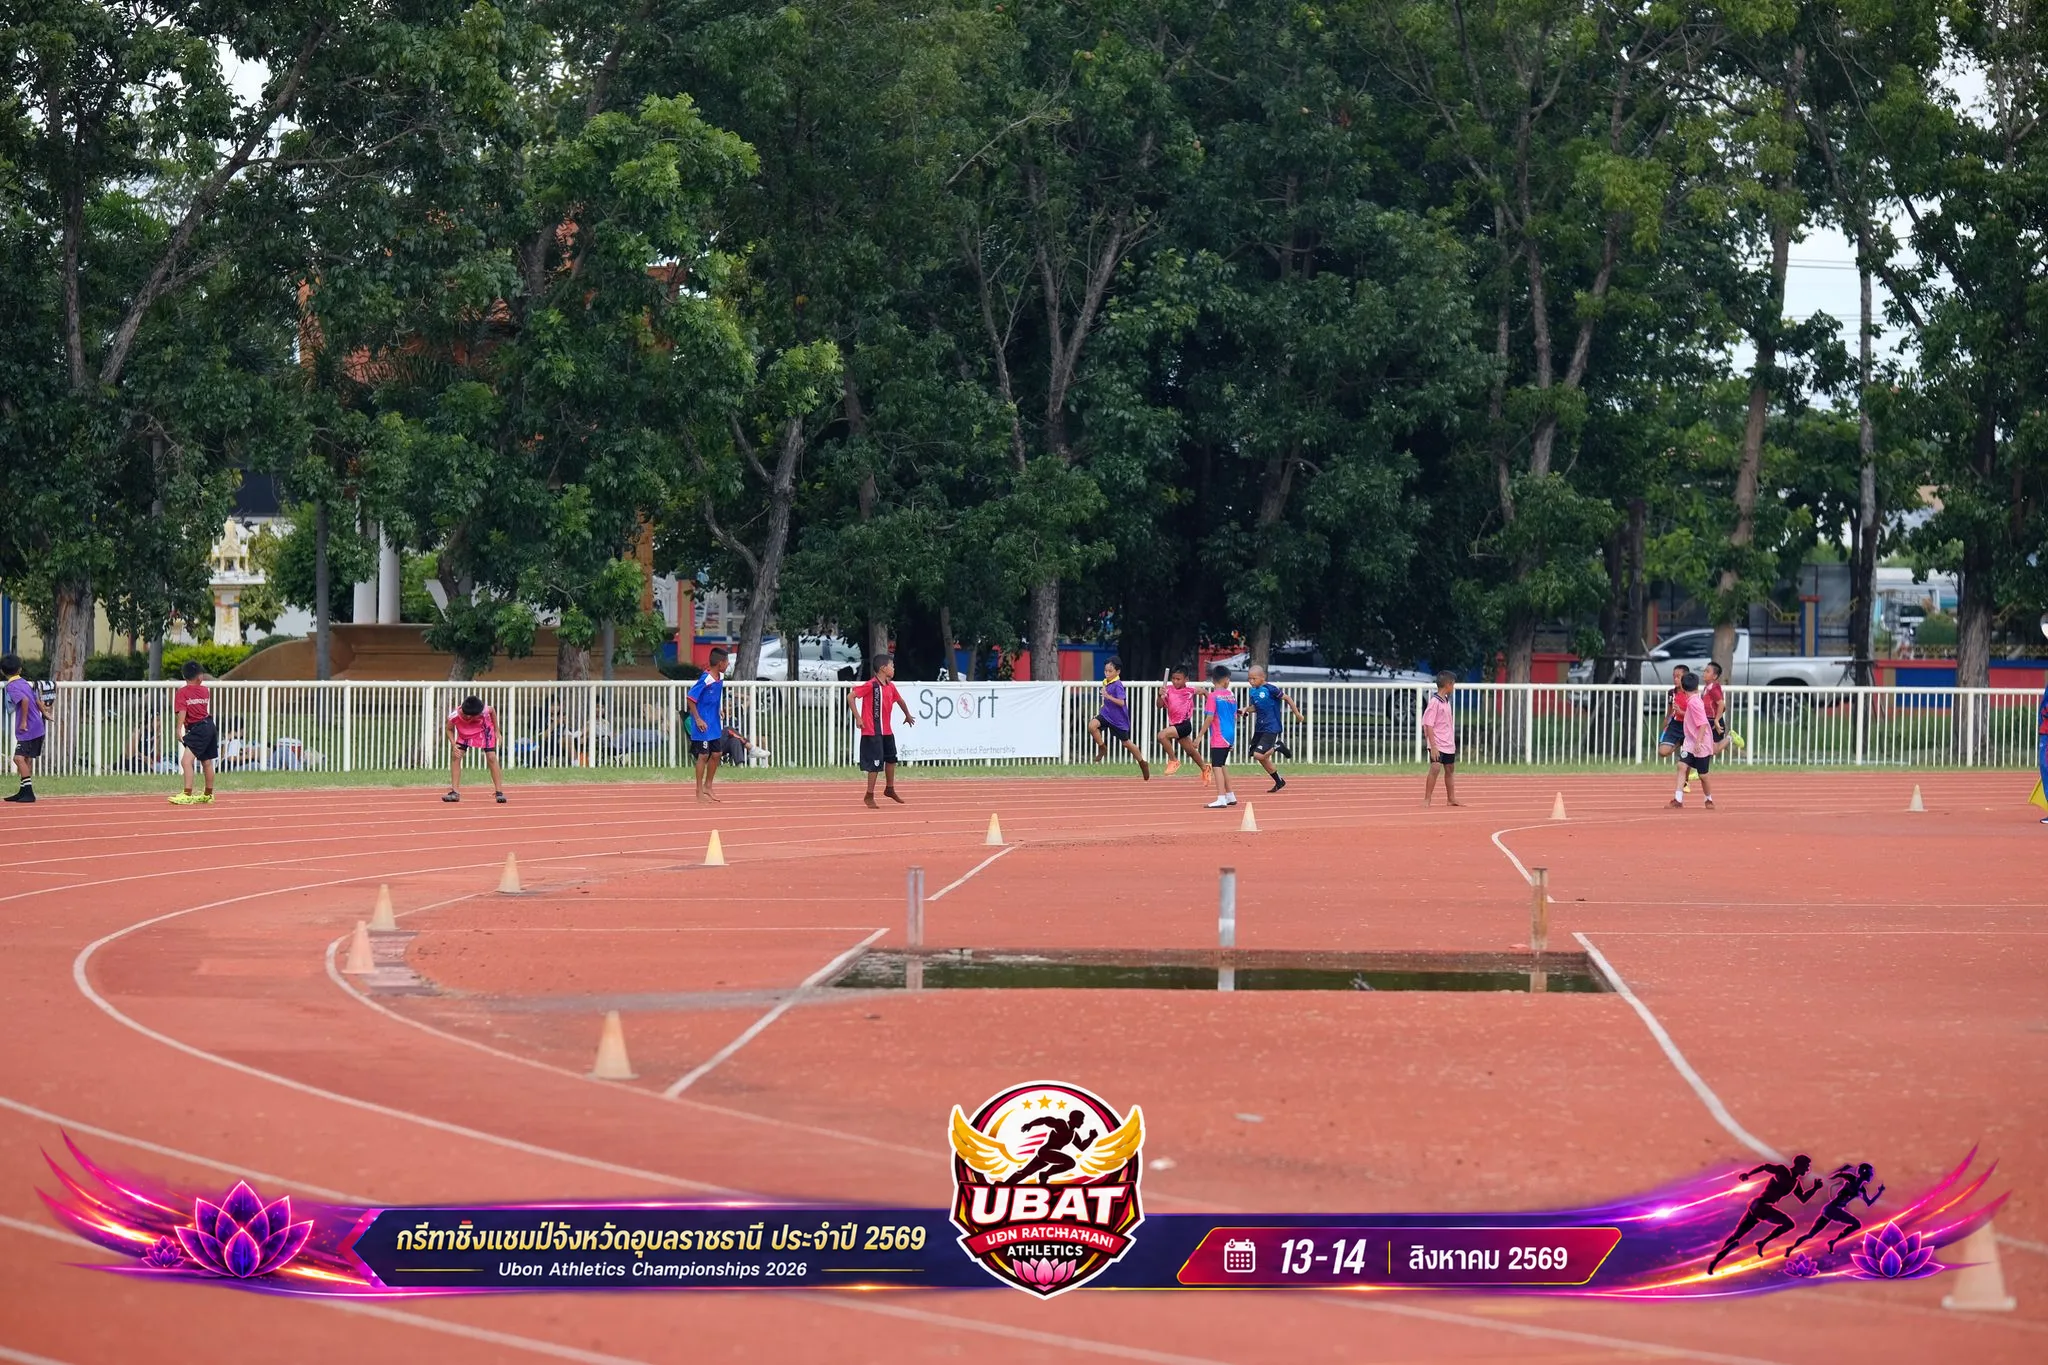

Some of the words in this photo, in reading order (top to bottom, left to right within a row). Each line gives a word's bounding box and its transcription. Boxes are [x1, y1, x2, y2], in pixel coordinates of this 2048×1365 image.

[900, 746, 919, 757] Sport
[920, 746, 952, 757] Searching
[953, 746, 978, 755] Limited
[979, 745, 1016, 755] Partnership
